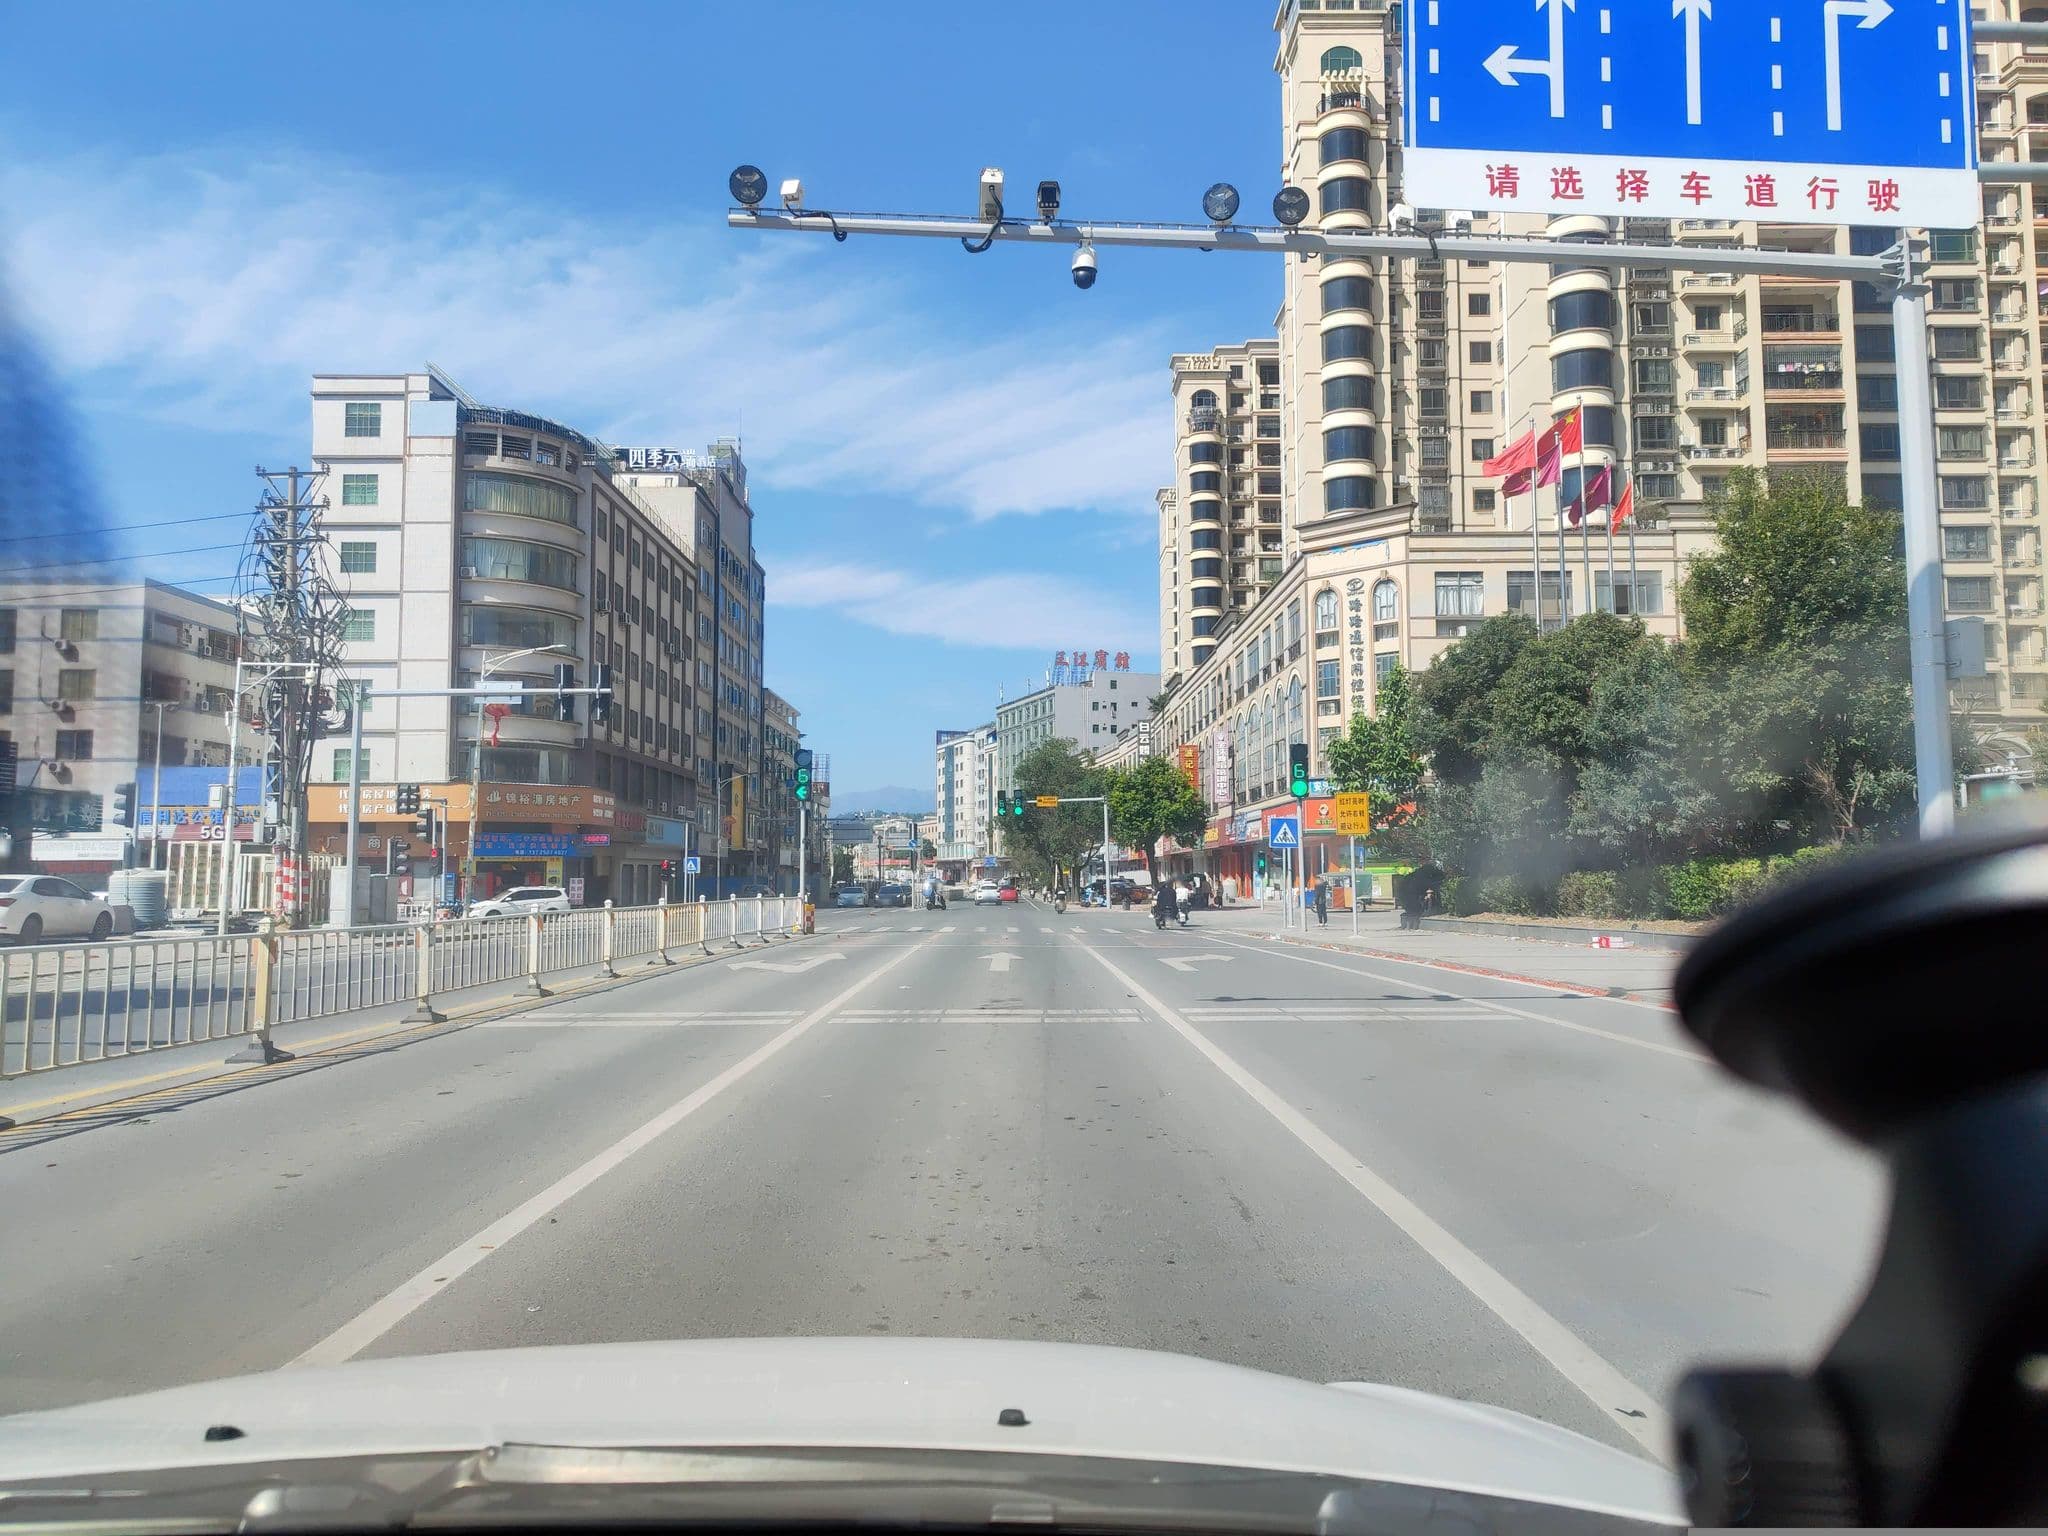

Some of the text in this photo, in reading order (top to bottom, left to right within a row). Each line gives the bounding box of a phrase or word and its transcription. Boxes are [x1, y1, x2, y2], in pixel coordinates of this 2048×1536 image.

[1486, 164, 1902, 213] 请选择车道行驶
[1293, 763, 1306, 779] 6
[200, 825, 225, 840] 5G
